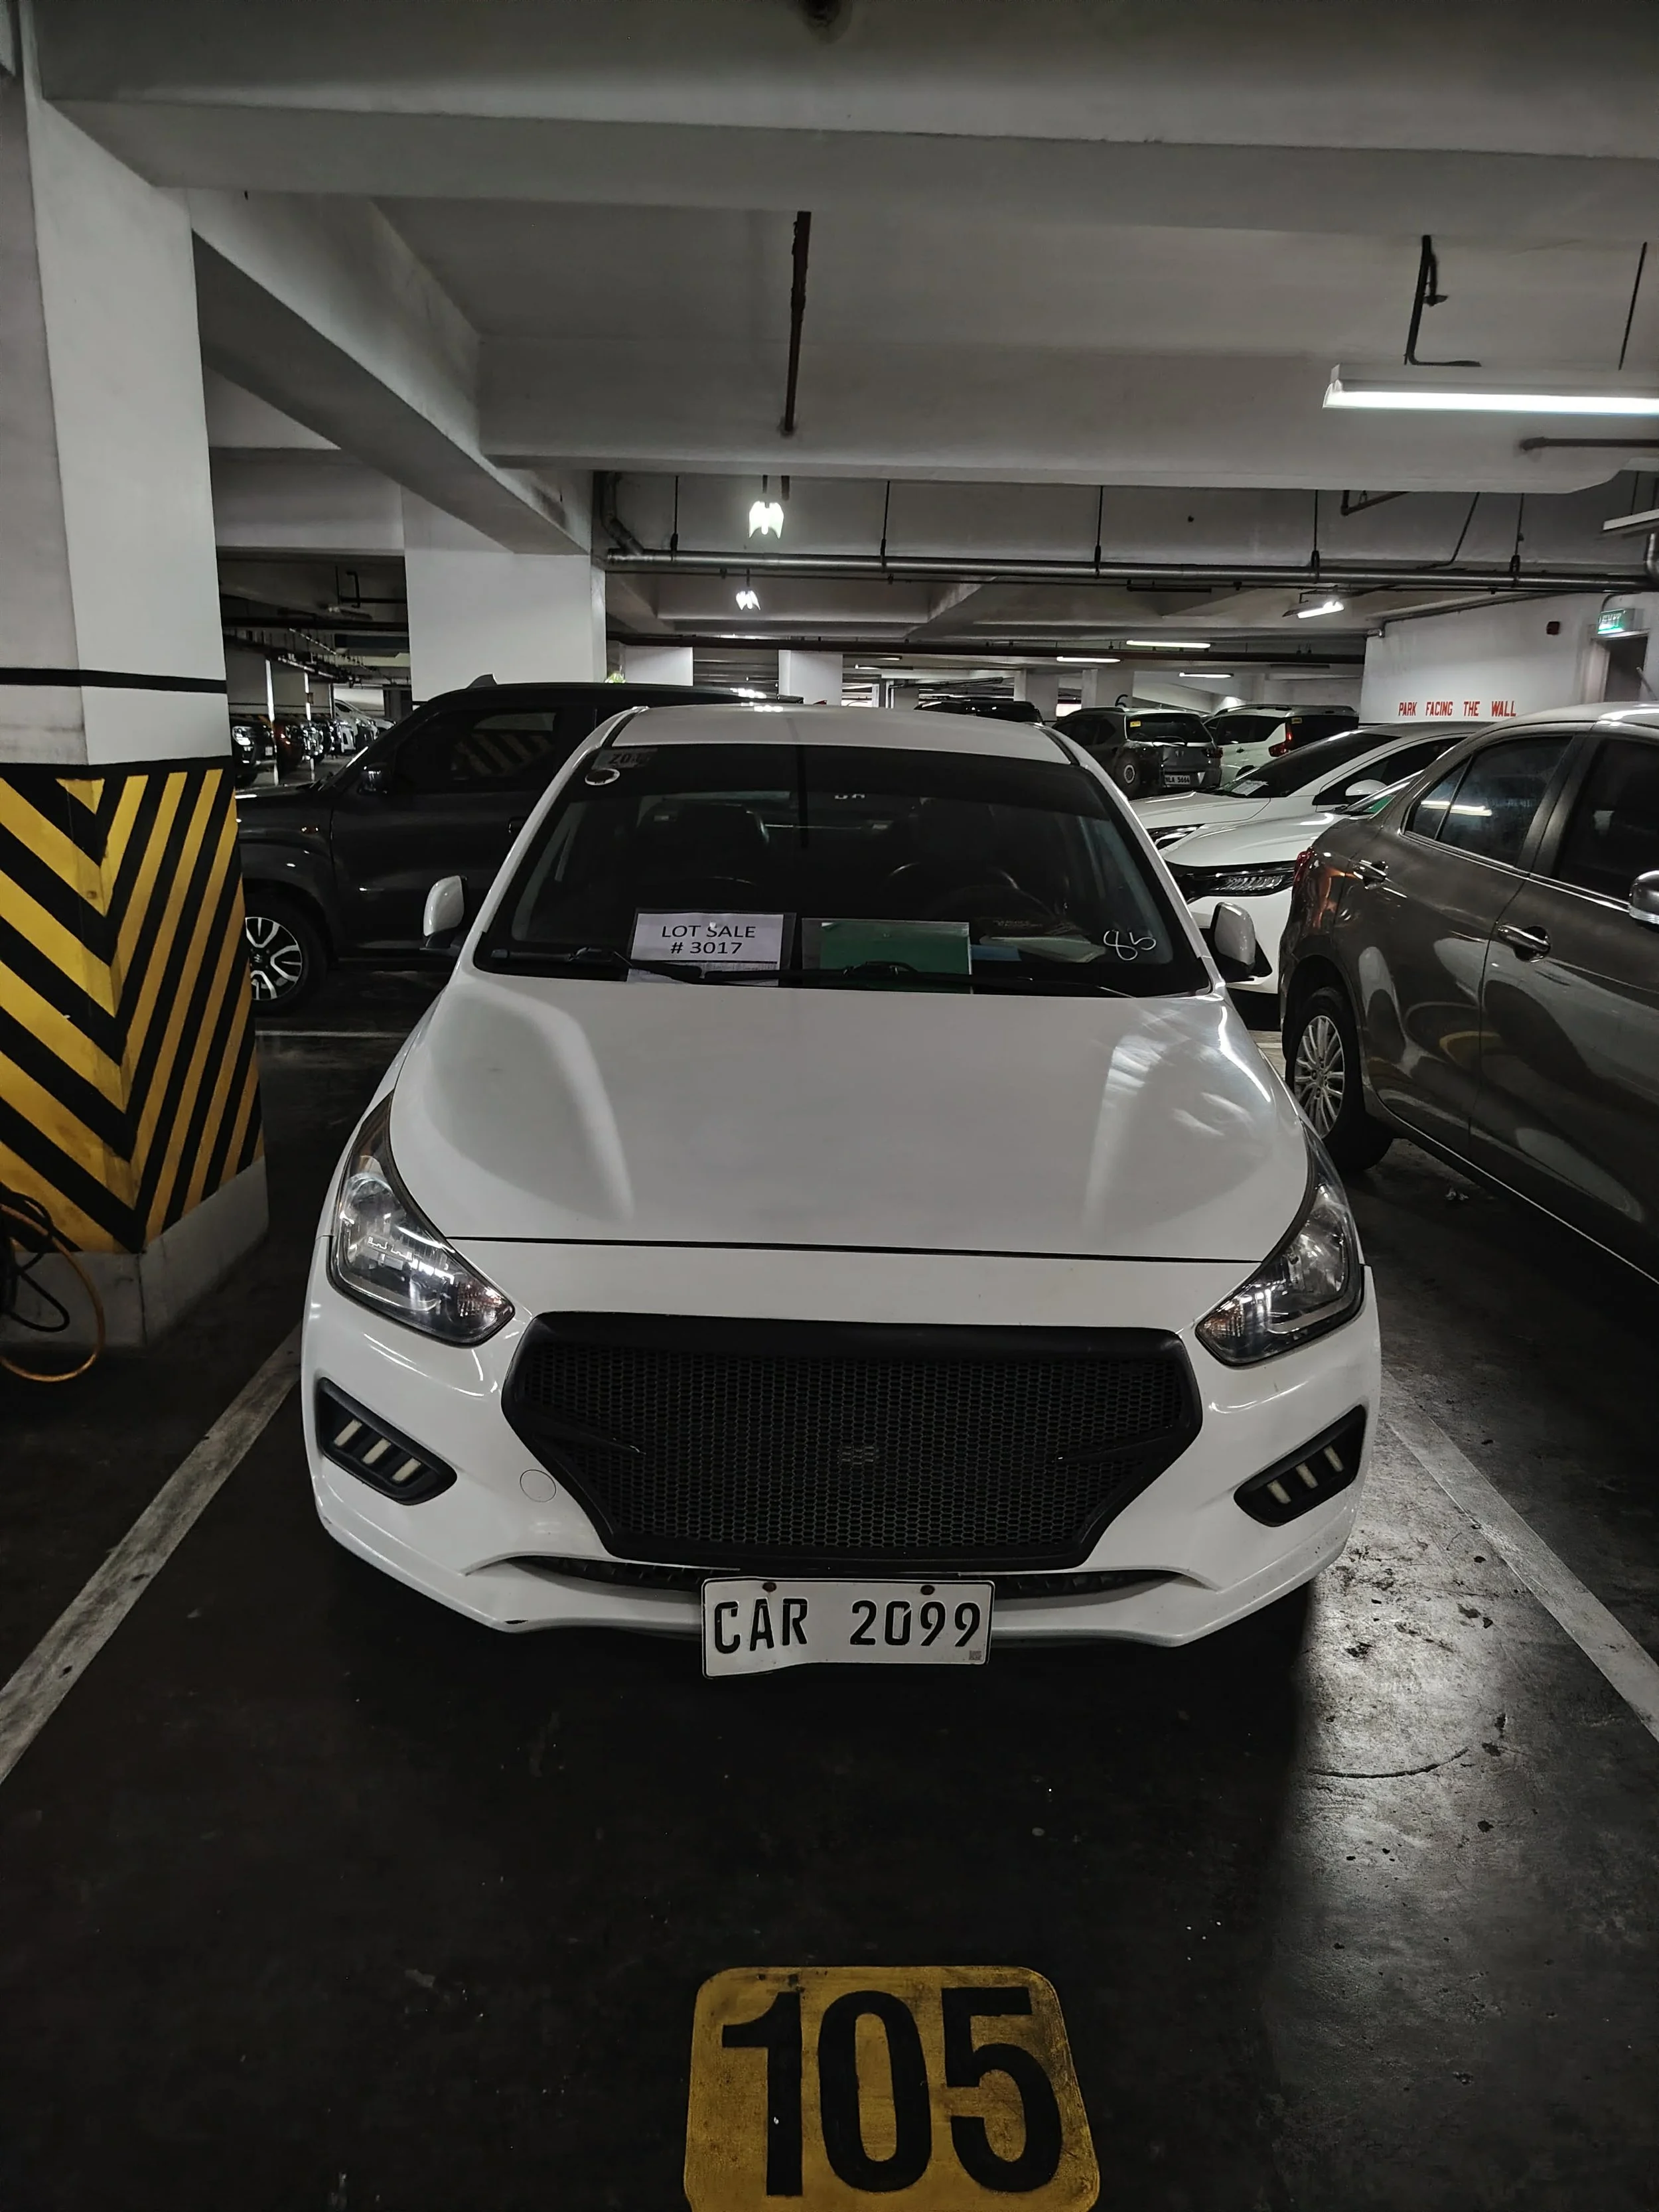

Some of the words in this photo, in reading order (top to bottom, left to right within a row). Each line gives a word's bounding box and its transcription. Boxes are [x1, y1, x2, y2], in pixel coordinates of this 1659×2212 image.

[1398, 702, 1417, 716] PARK
[1425, 701, 1453, 716] FACING
[1463, 701, 1480, 717] THE
[1491, 700, 1517, 717] WALL
[662, 925, 701, 938] LOT
[706, 926, 756, 938] SALE
[670, 942, 684, 954] #
[689, 942, 743, 954] 3017
[714, 1598, 808, 1654] CAR
[849, 1600, 981, 1647] 2099
[721, 1986, 1063, 2196] 105
